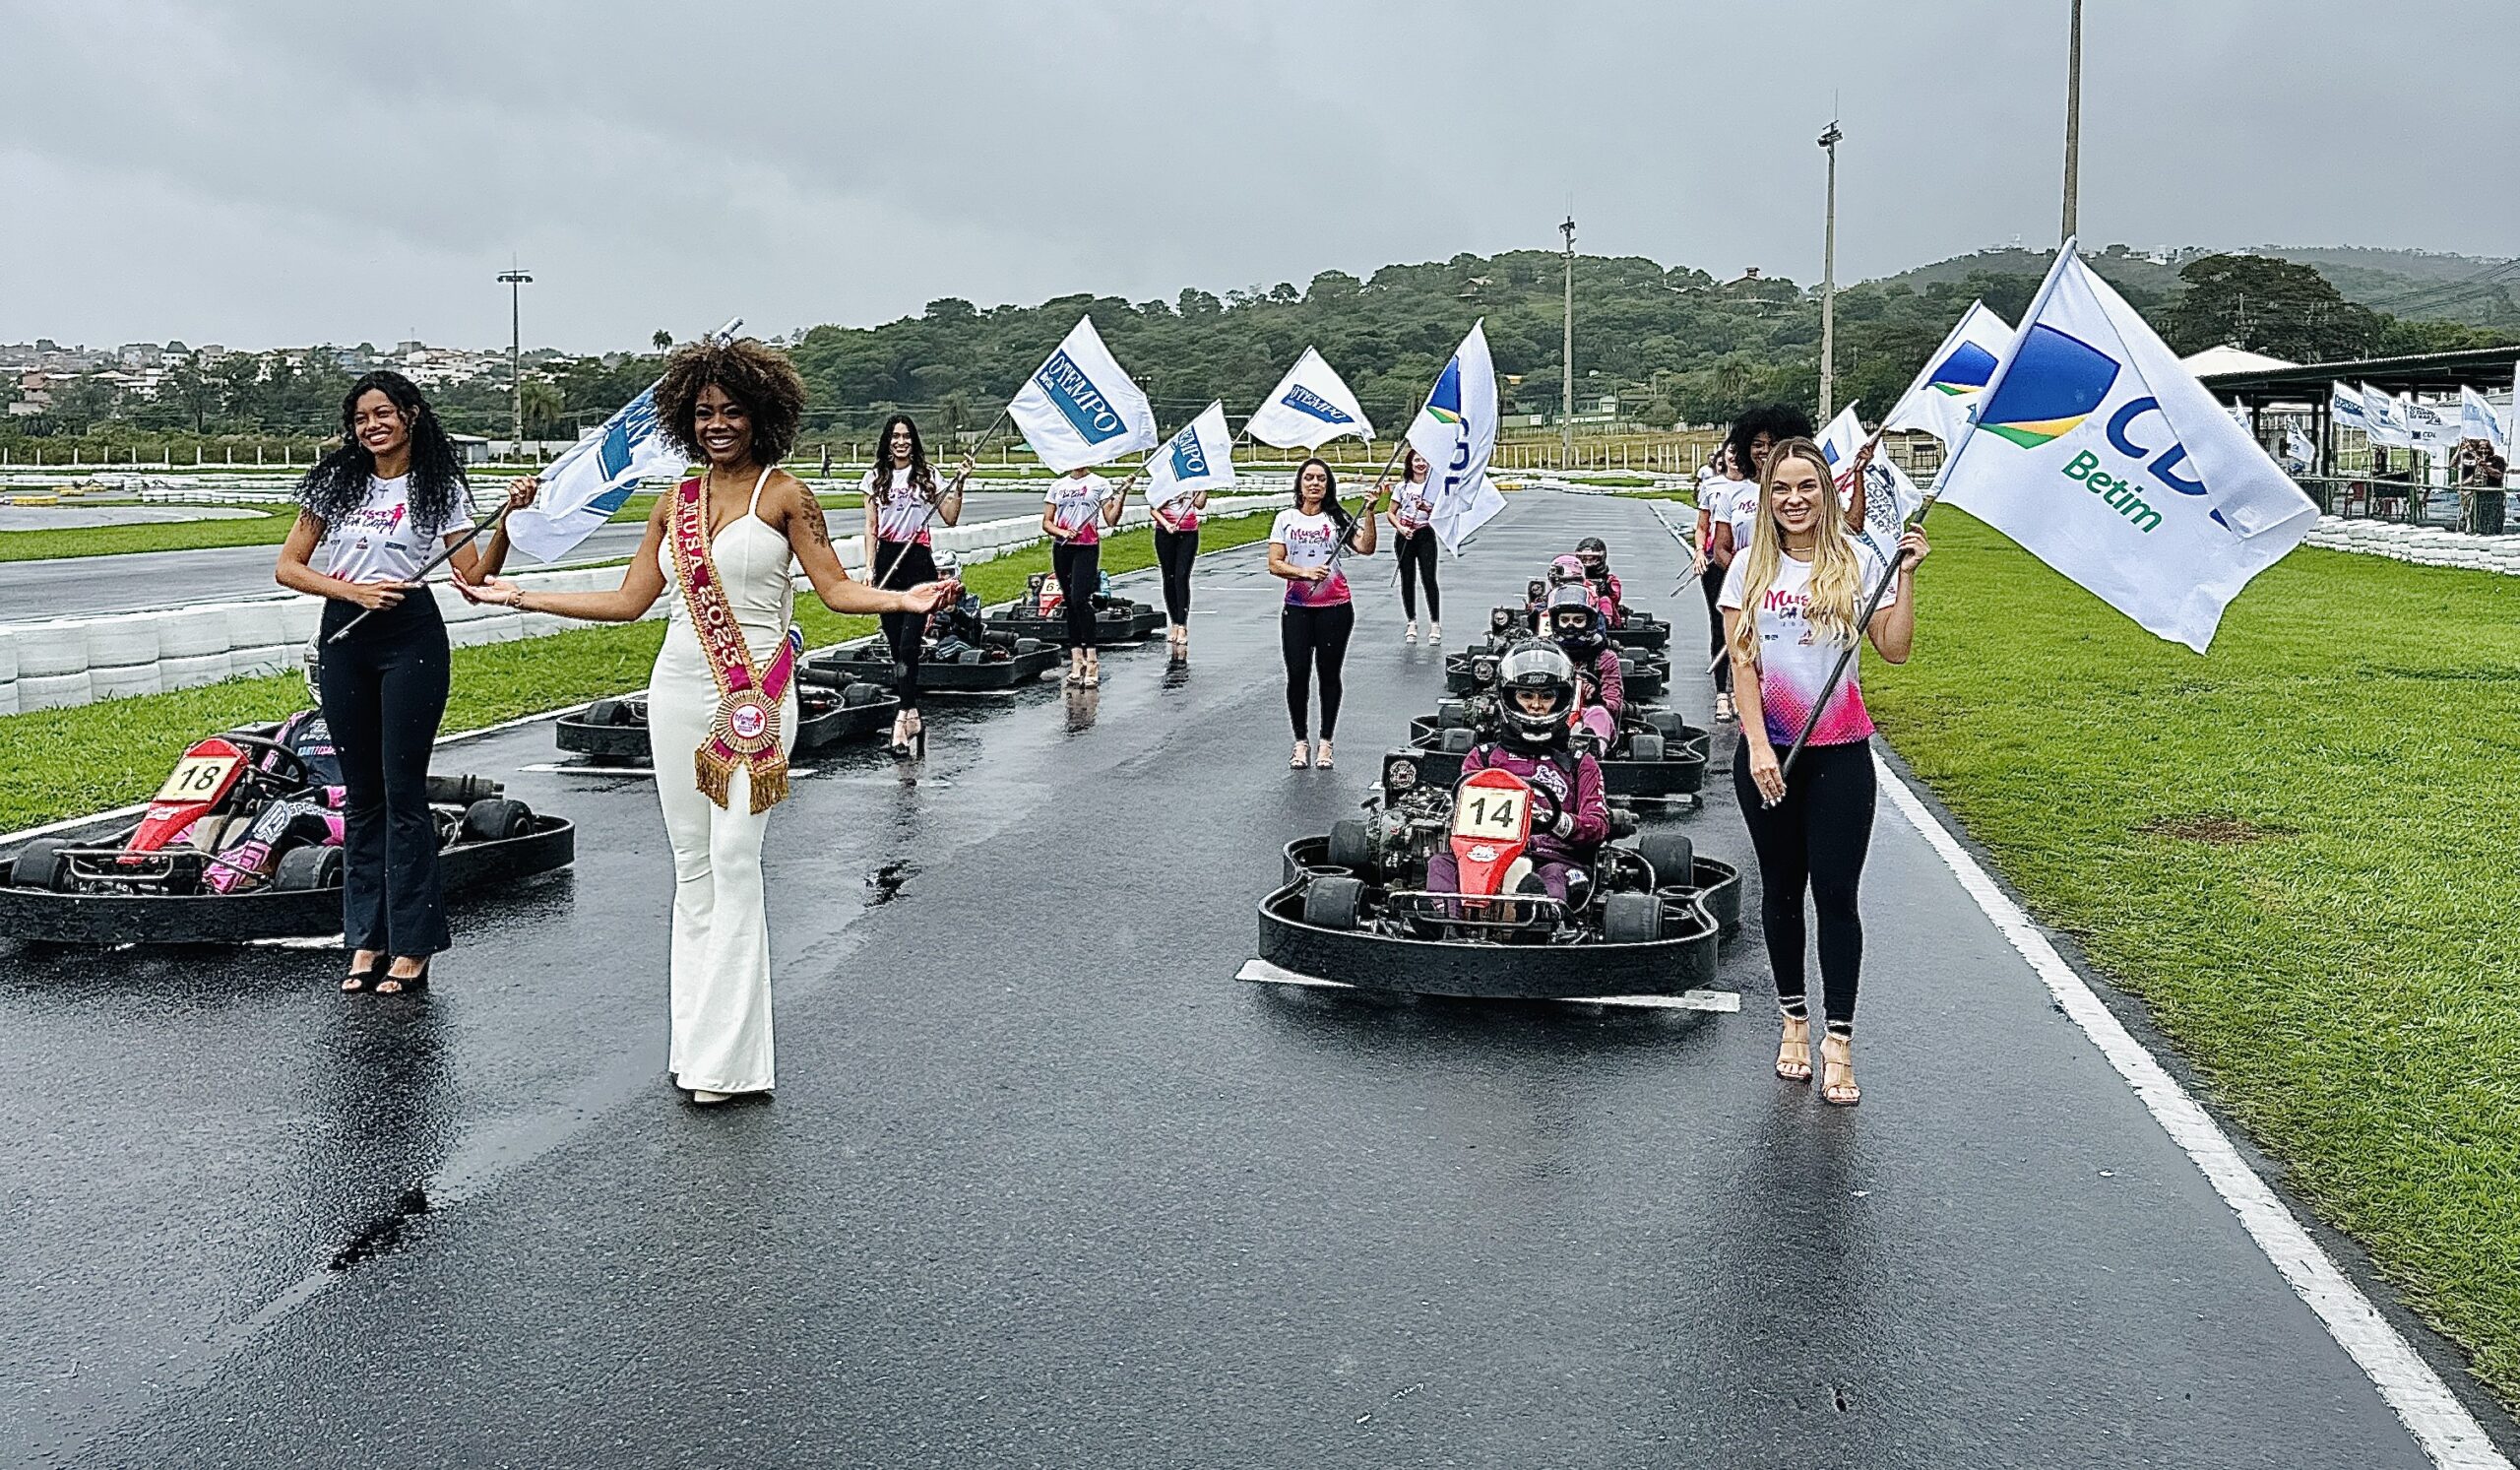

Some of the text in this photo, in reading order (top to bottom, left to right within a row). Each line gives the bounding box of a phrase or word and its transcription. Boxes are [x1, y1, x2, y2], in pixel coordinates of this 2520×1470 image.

[2061, 449, 2162, 533] Betim
[682, 499, 743, 669] MUSA 2023
[1764, 590, 1810, 611] Mus
[181, 764, 221, 792] 18
[1469, 797, 1515, 829] 14
